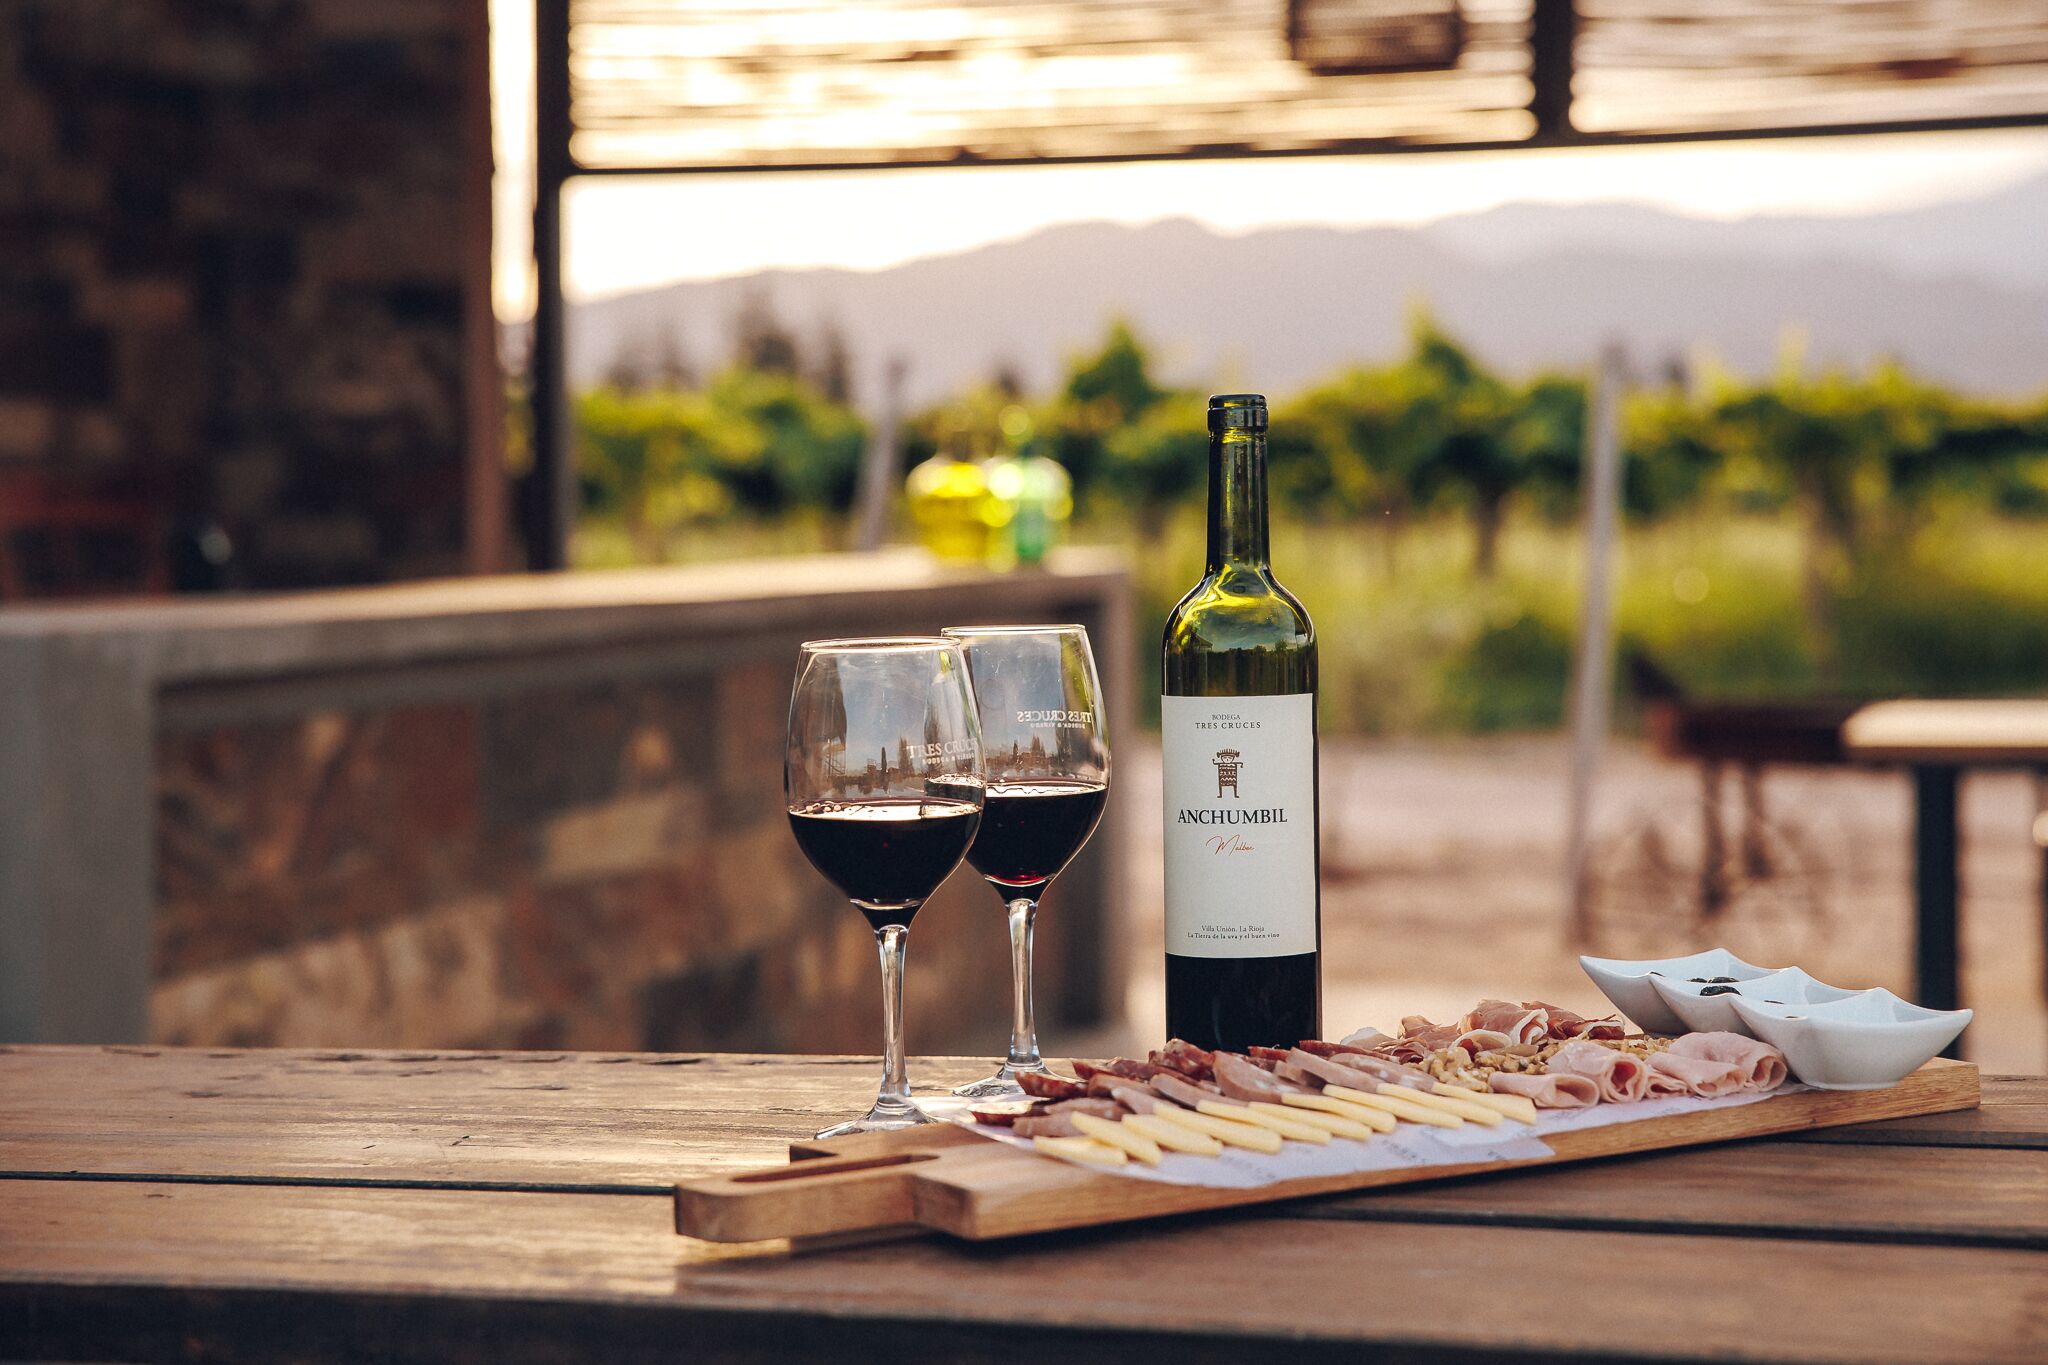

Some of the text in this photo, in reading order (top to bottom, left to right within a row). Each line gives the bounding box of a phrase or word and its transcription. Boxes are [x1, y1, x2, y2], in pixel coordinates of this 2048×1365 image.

[906, 742, 942, 758] TRES
[1178, 808, 1288, 824] ANCHUMBIL
[1248, 925, 1265, 933] Rioja
